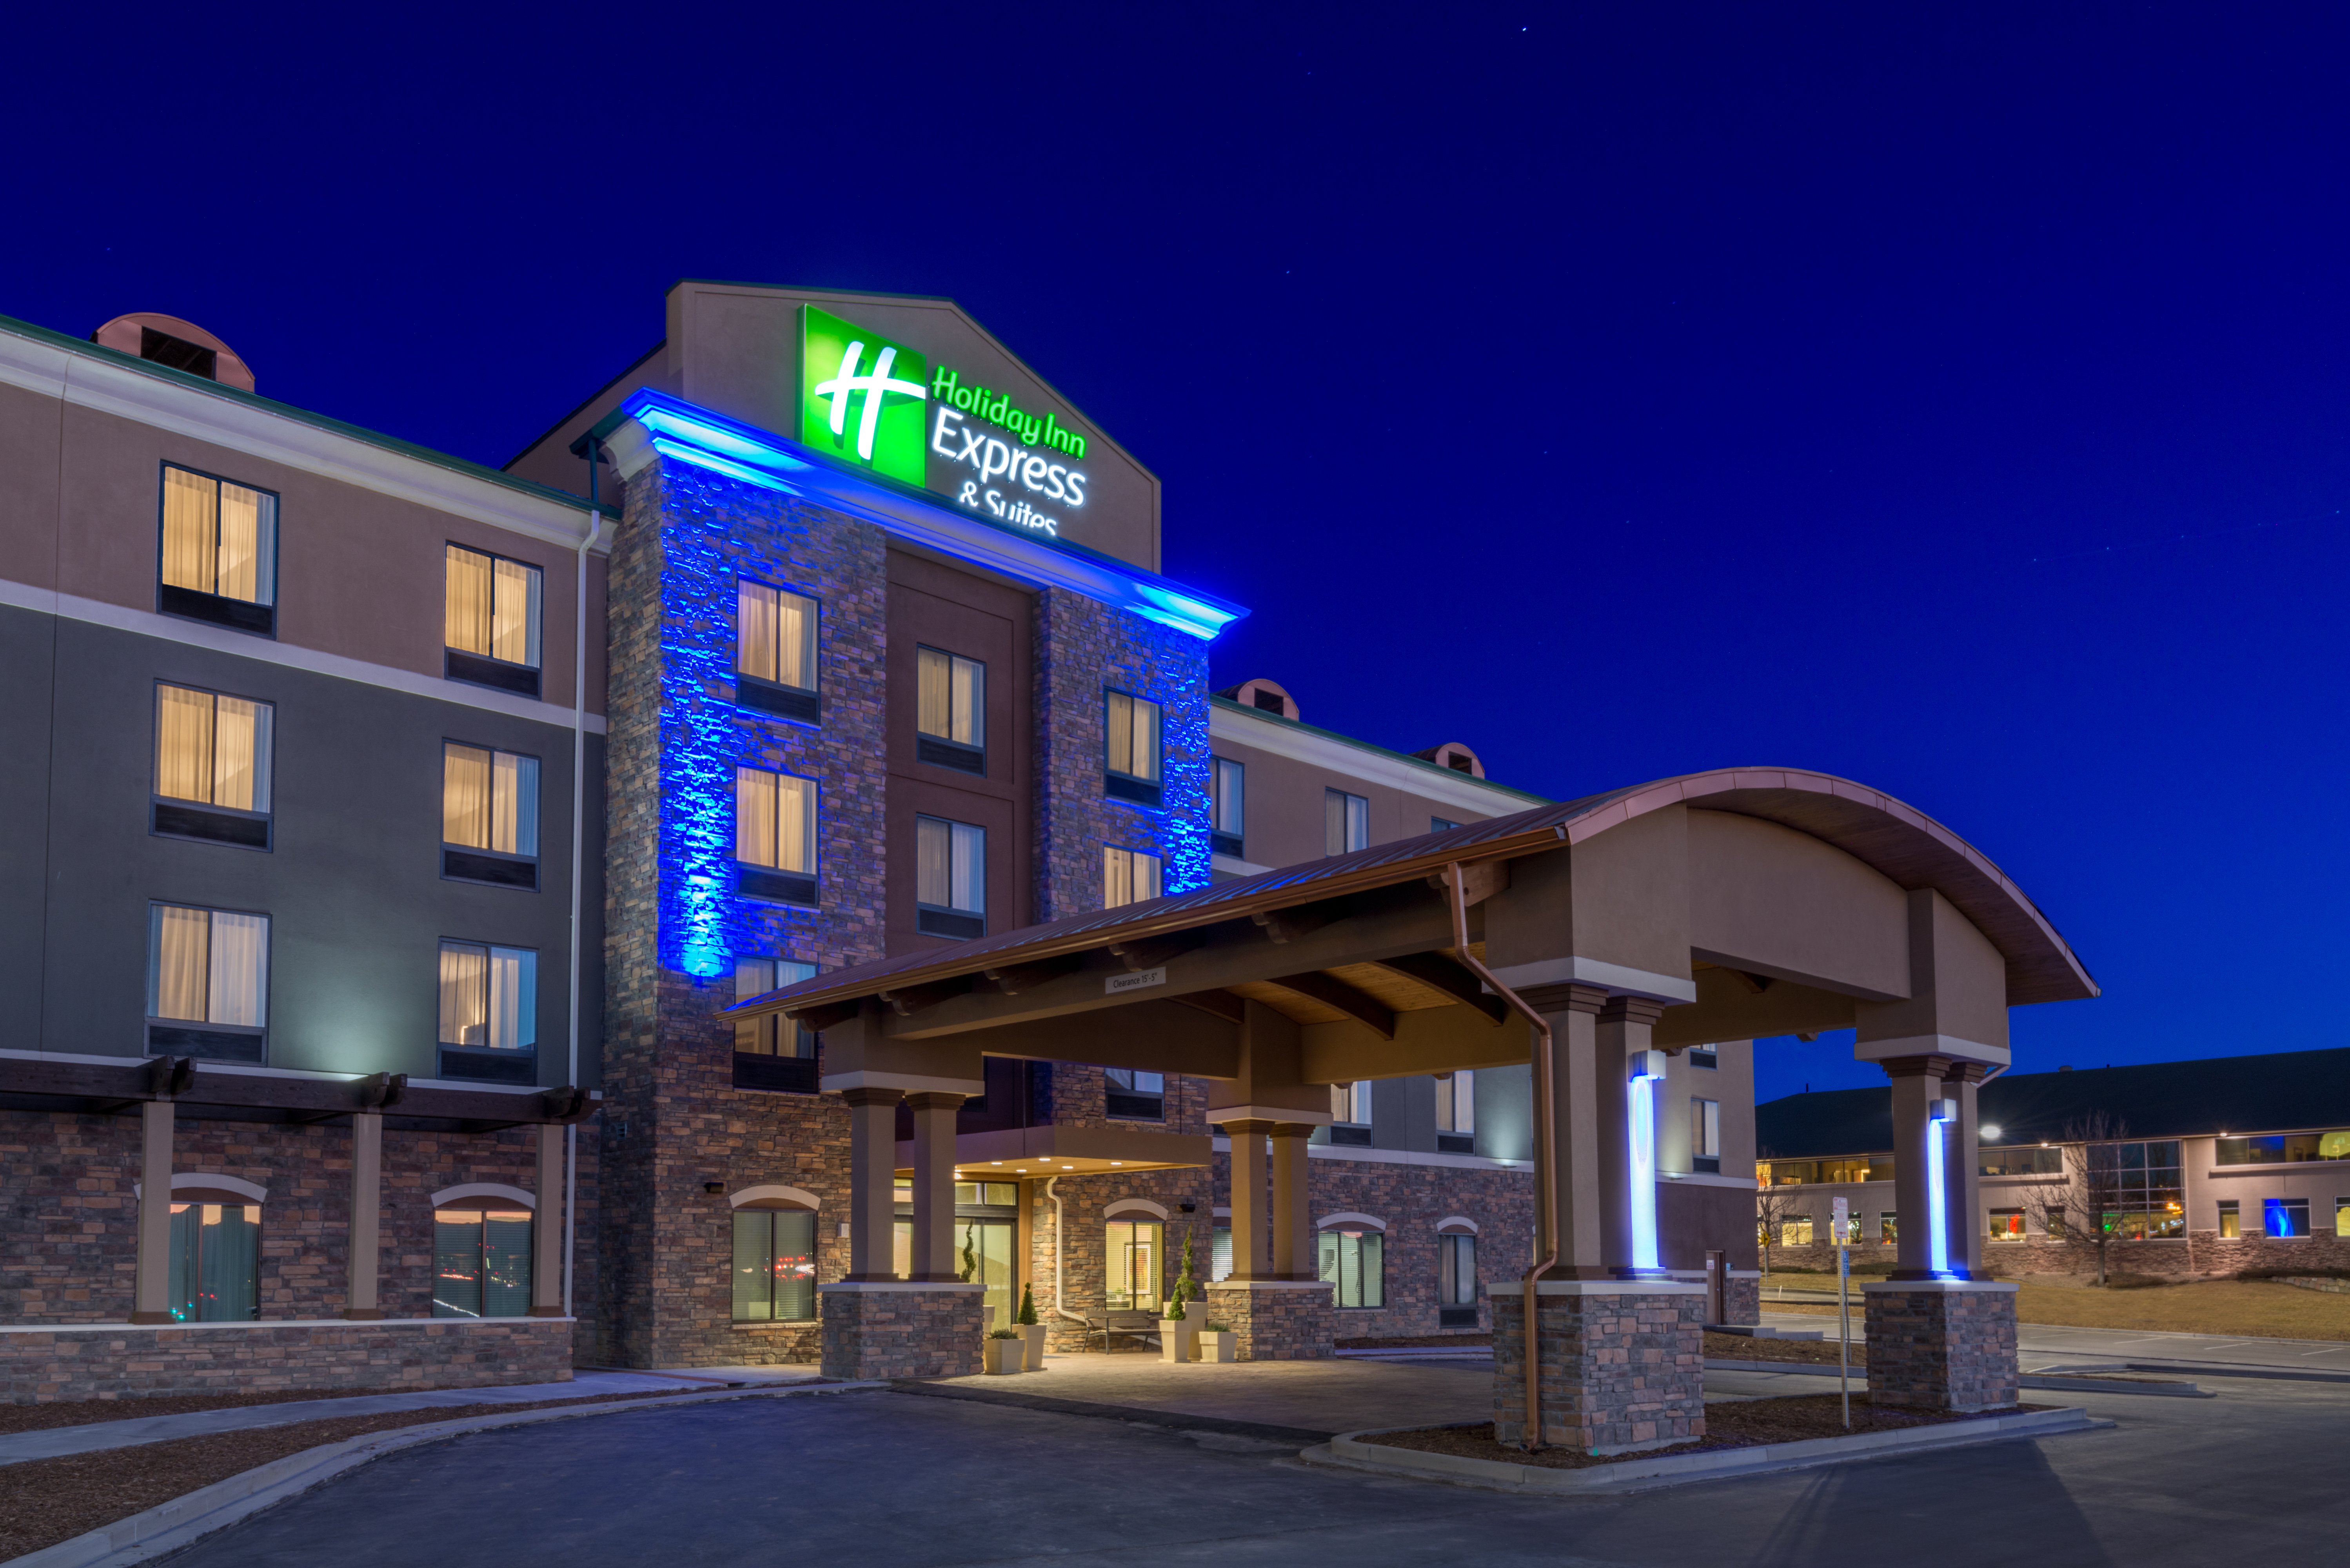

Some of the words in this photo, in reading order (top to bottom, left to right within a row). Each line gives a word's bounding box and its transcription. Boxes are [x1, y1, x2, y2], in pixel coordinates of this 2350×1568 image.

[931, 365, 1042, 446] Holiday
[1044, 413, 1086, 459] Inn
[932, 406, 1086, 506] Express
[959, 481, 979, 507] &
[1113, 978, 1140, 988] Clearance
